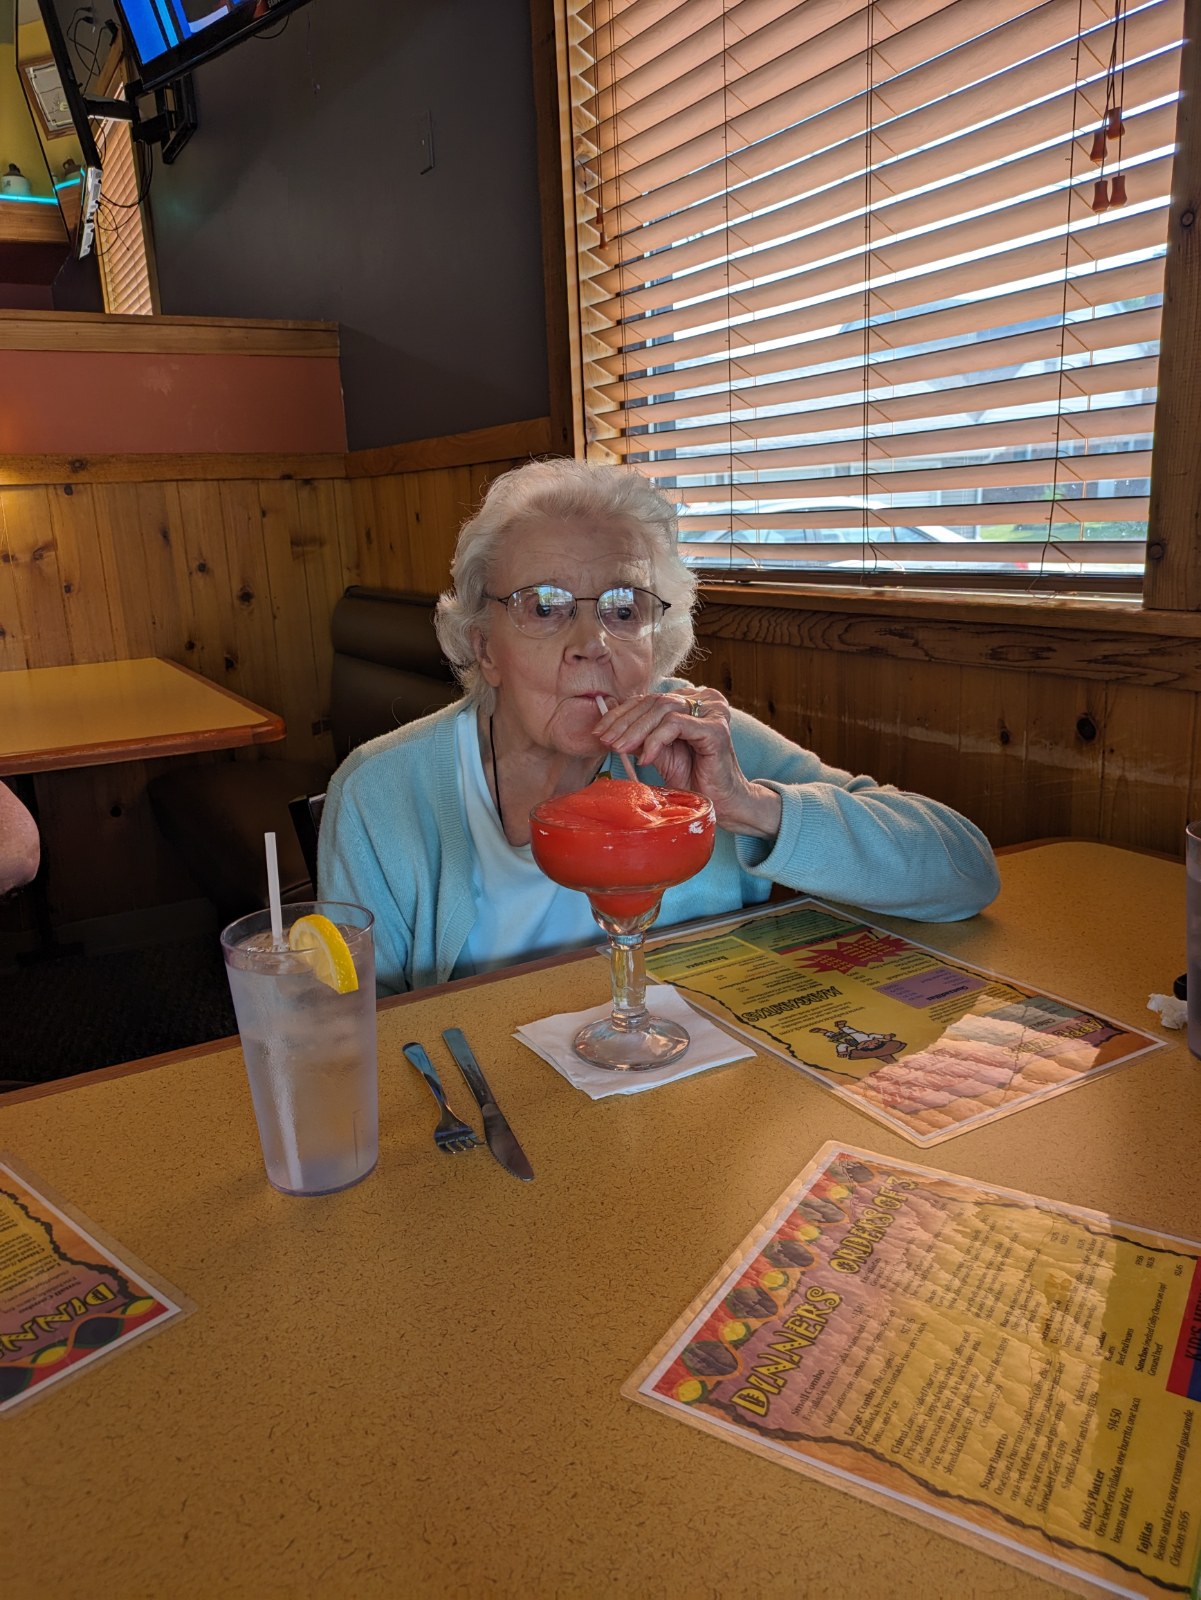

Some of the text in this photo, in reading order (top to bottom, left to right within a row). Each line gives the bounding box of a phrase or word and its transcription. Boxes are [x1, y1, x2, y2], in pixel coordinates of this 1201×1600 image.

[739, 987, 846, 1022] MARGARITAS
[887, 1175, 920, 1193] 3
[872, 1188, 913, 1212] OF
[830, 1210, 897, 1275] ORDERS
[0, 1281, 118, 1358] DINN
[1123, 1328, 1135, 1343] beans
[1134, 1346, 1149, 1371] Sanchos
[1150, 1298, 1162, 1314] Cheese
[731, 1285, 843, 1416] DINNERS
[1120, 1342, 1130, 1353] and
[1146, 1342, 1163, 1375] Ground beef
[789, 1368, 825, 1415] Small Combo
[844, 1414, 864, 1436] Large
[857, 1388, 877, 1413] Combo
[1126, 1411, 1137, 1425] one
[1076, 1426, 1088, 1440] and
[1072, 1438, 1084, 1454] Beef
[1115, 1450, 1127, 1465] one
[1174, 1445, 1186, 1460] and
[979, 1432, 1009, 1490] Super Burrito
[1018, 1459, 1030, 1470] of
[1170, 1460, 1184, 1484] cream
[1037, 1476, 1056, 1512] Shredded
[1078, 1467, 1105, 1530] Rudy's Platter
[1166, 1483, 1178, 1501] sour
[1098, 1501, 1112, 1519] beef
[1094, 1519, 1108, 1537] One
[1111, 1518, 1125, 1543] beans
[1118, 1502, 1130, 1518] and
[1158, 1518, 1172, 1534] and
[1137, 1520, 1156, 1555] Fajitas
[1154, 1534, 1168, 1560] Beans
